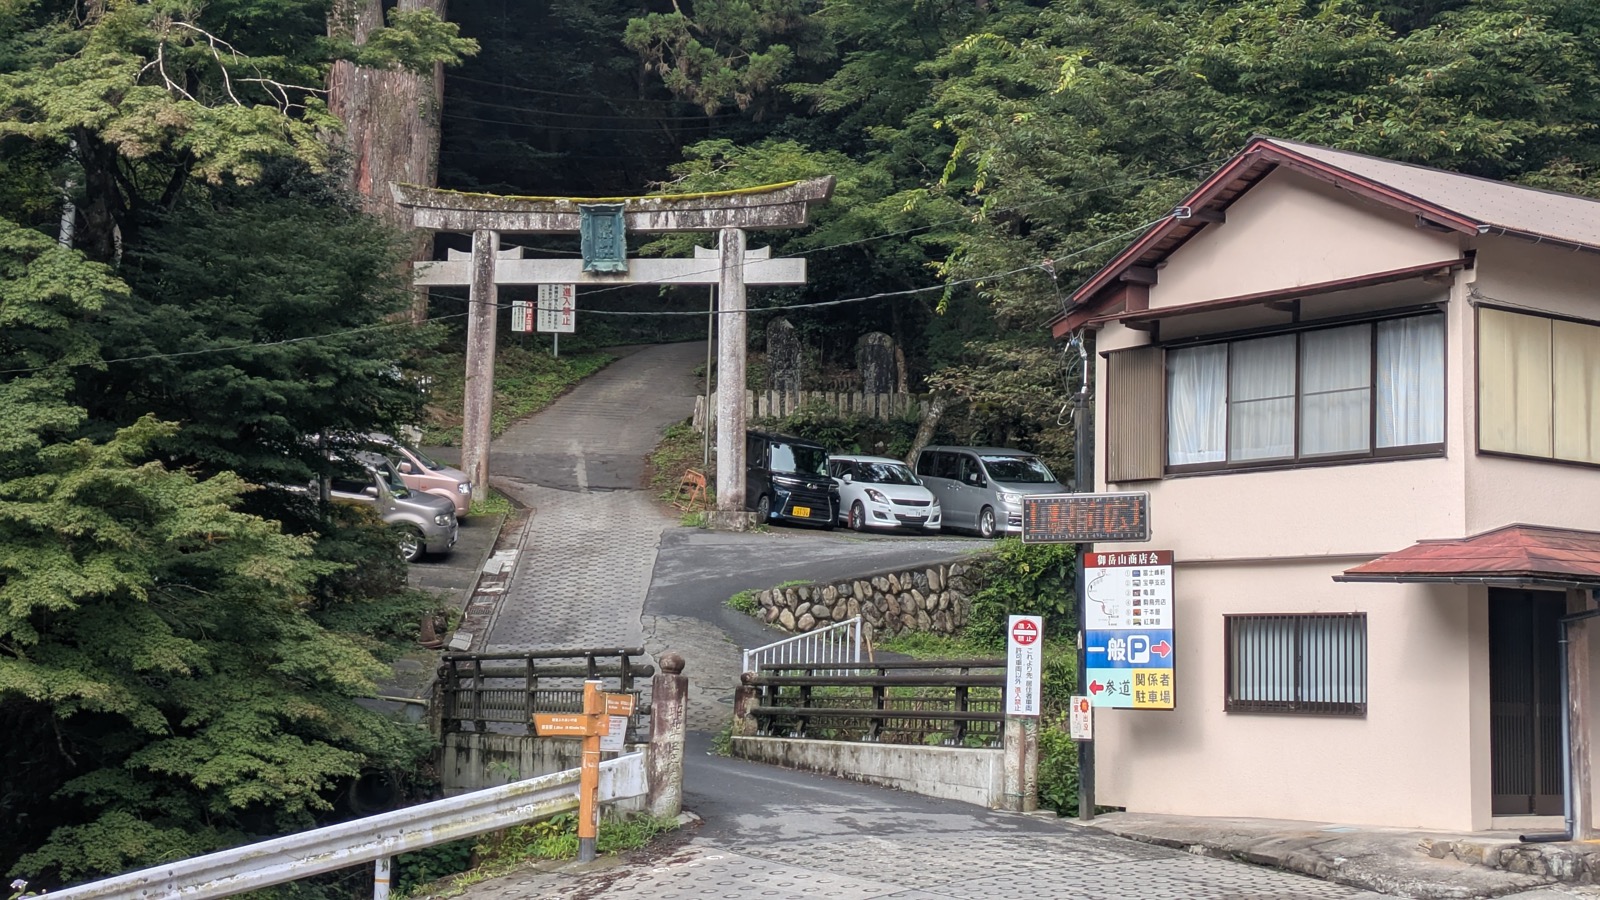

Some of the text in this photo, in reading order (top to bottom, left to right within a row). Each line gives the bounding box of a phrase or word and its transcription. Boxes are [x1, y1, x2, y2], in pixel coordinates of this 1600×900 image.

[1097, 552, 1158, 565] 御岳山商店会
[1135, 673, 1170, 686] 関係者
[1105, 679, 1131, 696] 参道
[1135, 690, 1170, 704] 駐車場
